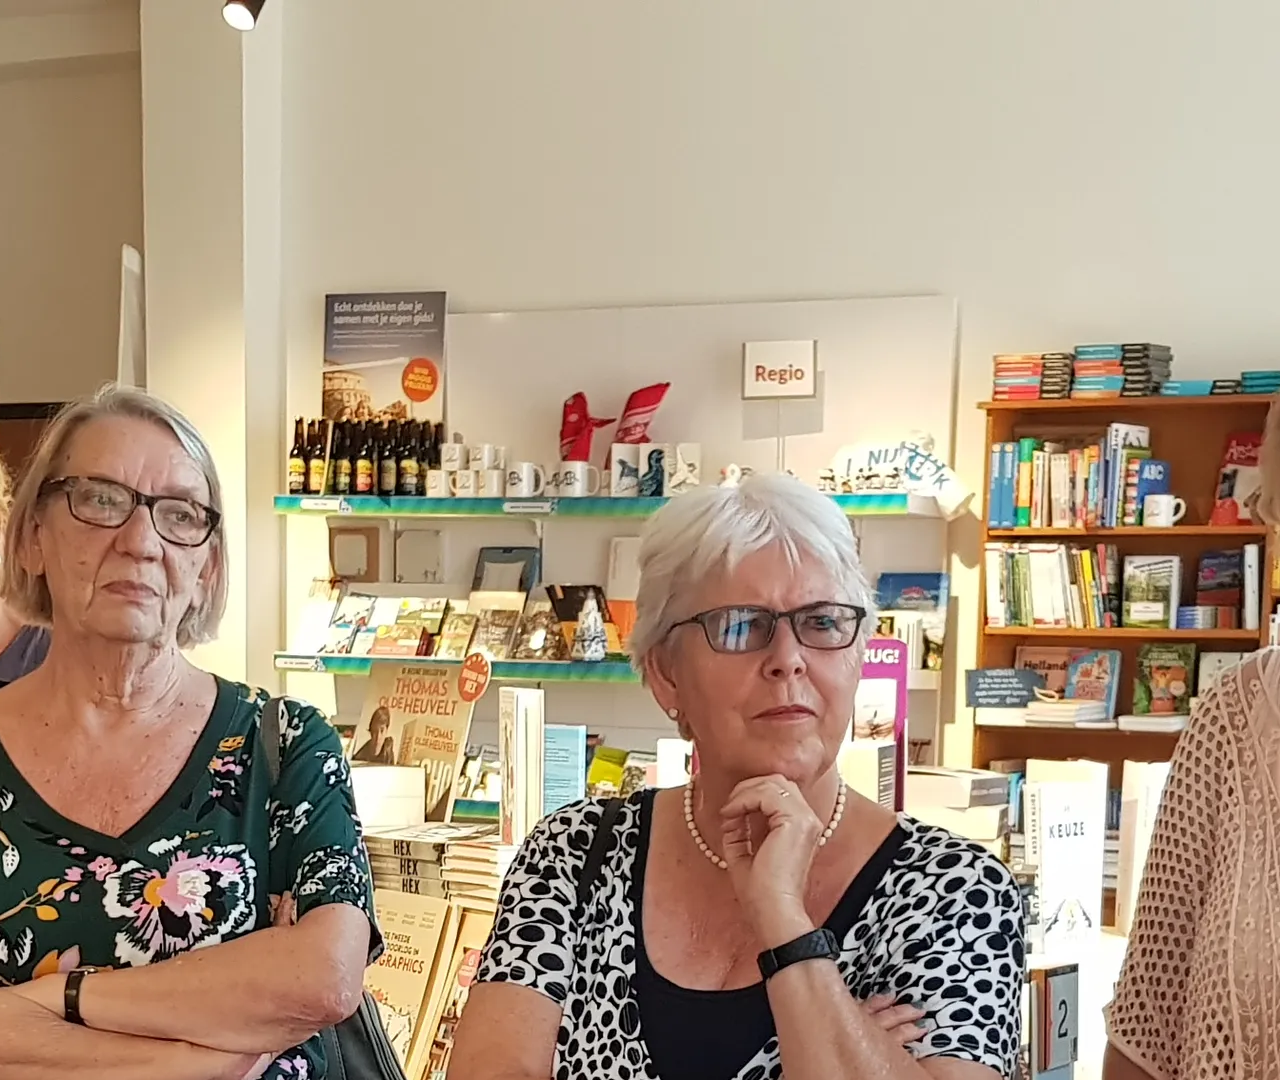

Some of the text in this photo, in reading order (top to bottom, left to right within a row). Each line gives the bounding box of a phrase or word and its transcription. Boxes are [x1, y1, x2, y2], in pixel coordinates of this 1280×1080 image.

[754, 363, 805, 385] Regio
[1141, 464, 1165, 480] ABC
[396, 677, 449, 696] THOMAS
[403, 700, 459, 717] HEUVELT
[424, 725, 455, 742] THOMAS
[1048, 821, 1085, 839] KEUZE
[393, 839, 412, 856] HEX
[399, 859, 418, 876] HEX
[401, 877, 420, 895] HEX
[378, 953, 425, 975] GRAPHICS
[1057, 999, 1068, 1038] 2
